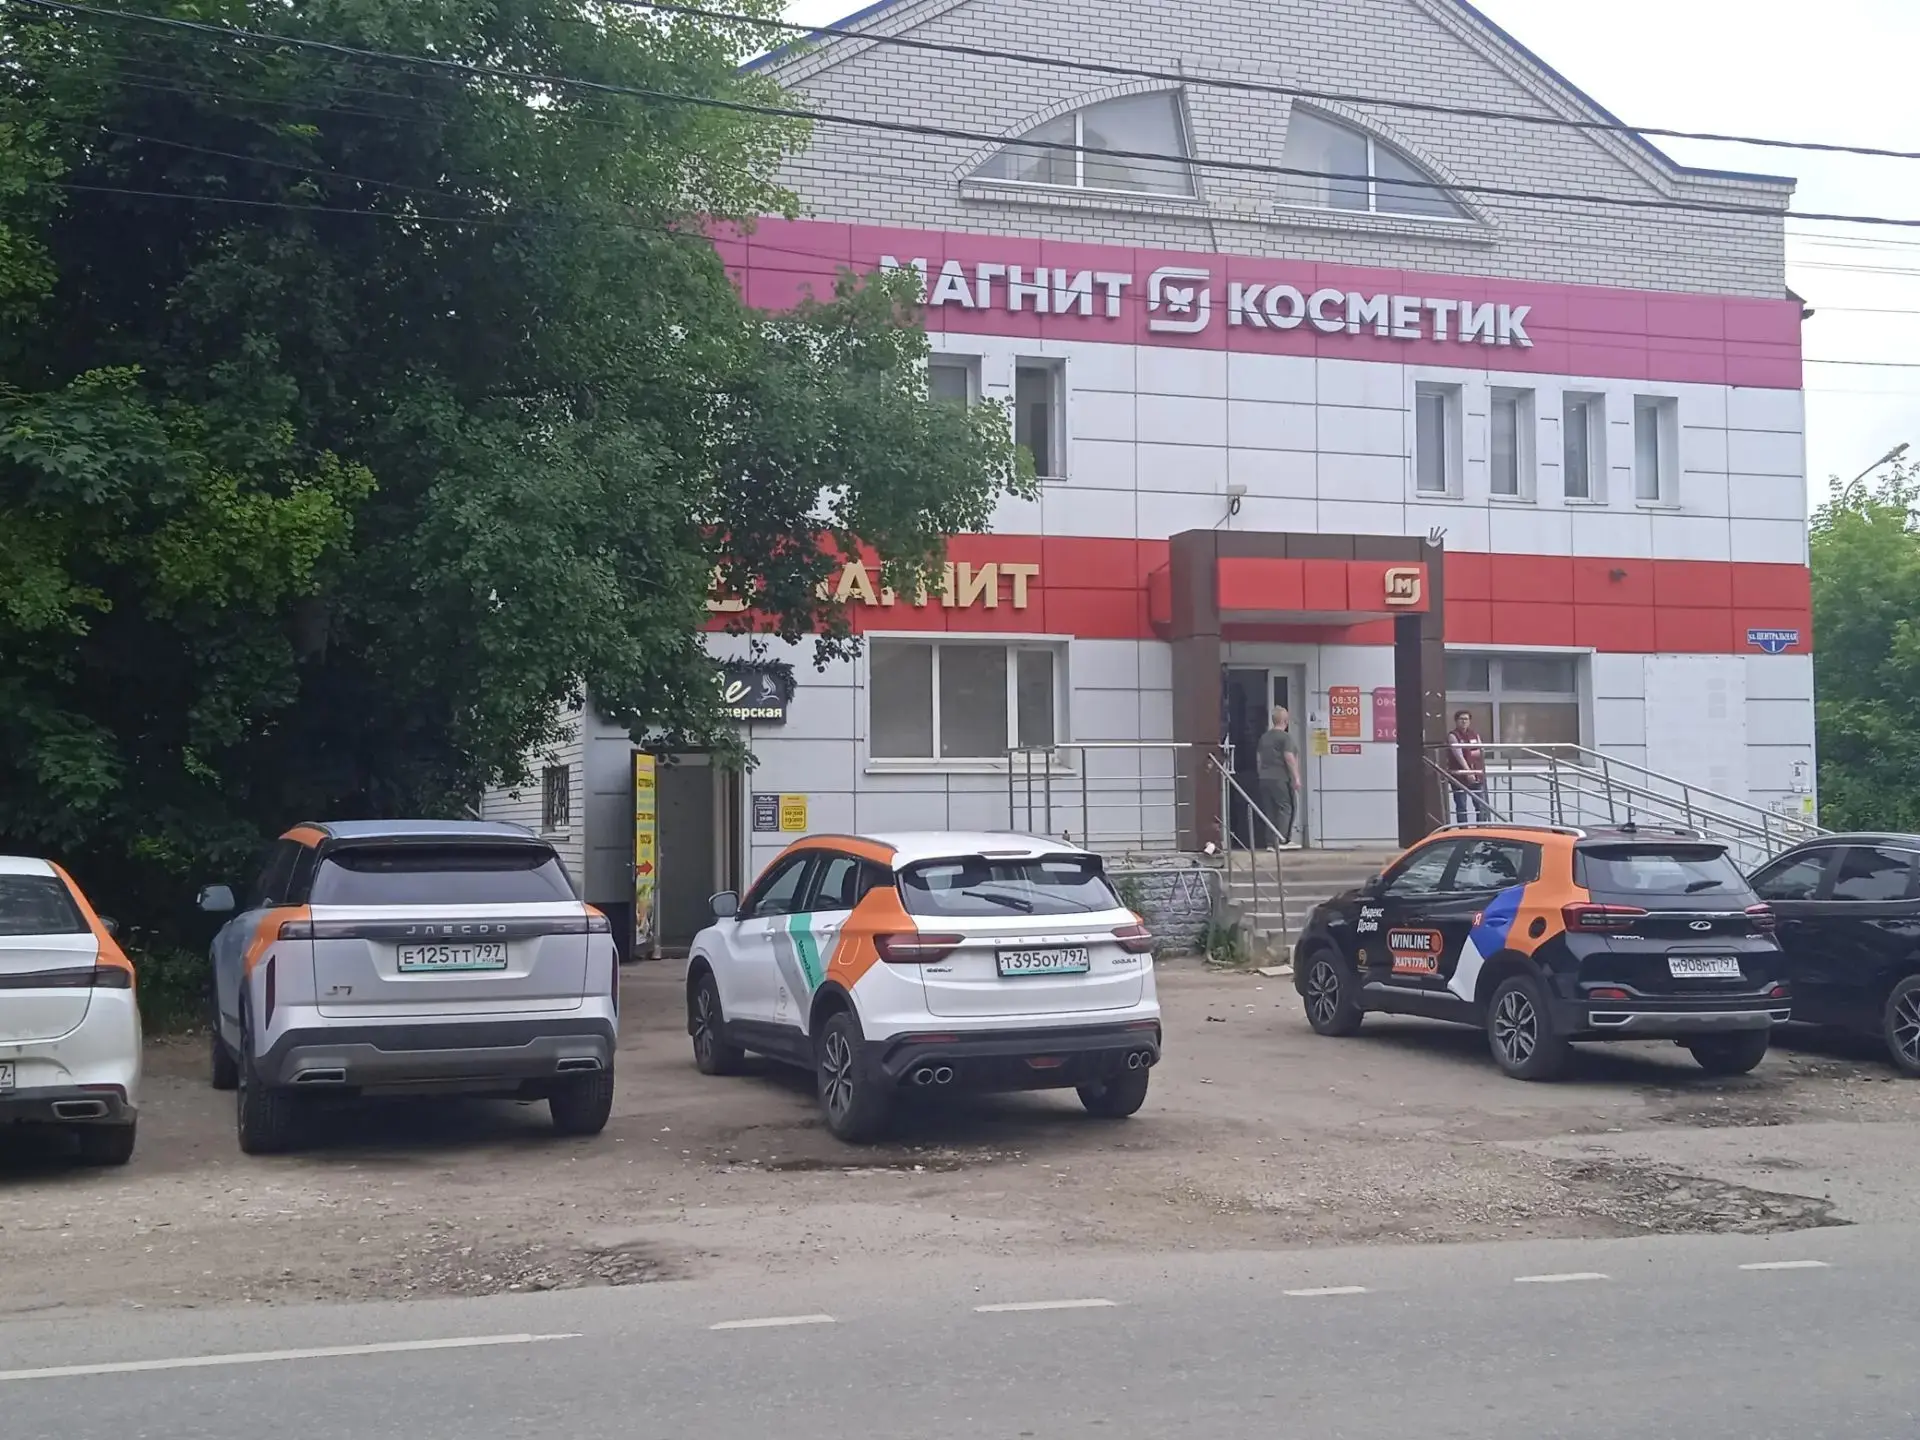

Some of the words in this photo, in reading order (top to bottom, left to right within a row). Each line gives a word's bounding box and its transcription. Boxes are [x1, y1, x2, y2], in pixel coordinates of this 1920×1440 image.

[1228, 282, 1534, 347] КОСМЕТИК
[1757, 631, 1798, 641] ЦЕНТРАЛЬНАЯ
[1770, 640, 1776, 652] 1
[1331, 696, 1358, 704] 08:30
[1360, 905, 1384, 919] Яндекс
[1356, 918, 1378, 933] Драйв
[1473, 912, 1483, 926] Я
[405, 924, 507, 935] JAECOO
[994, 935, 1091, 944] GEELY
[1391, 933, 1430, 949] WINLINE
